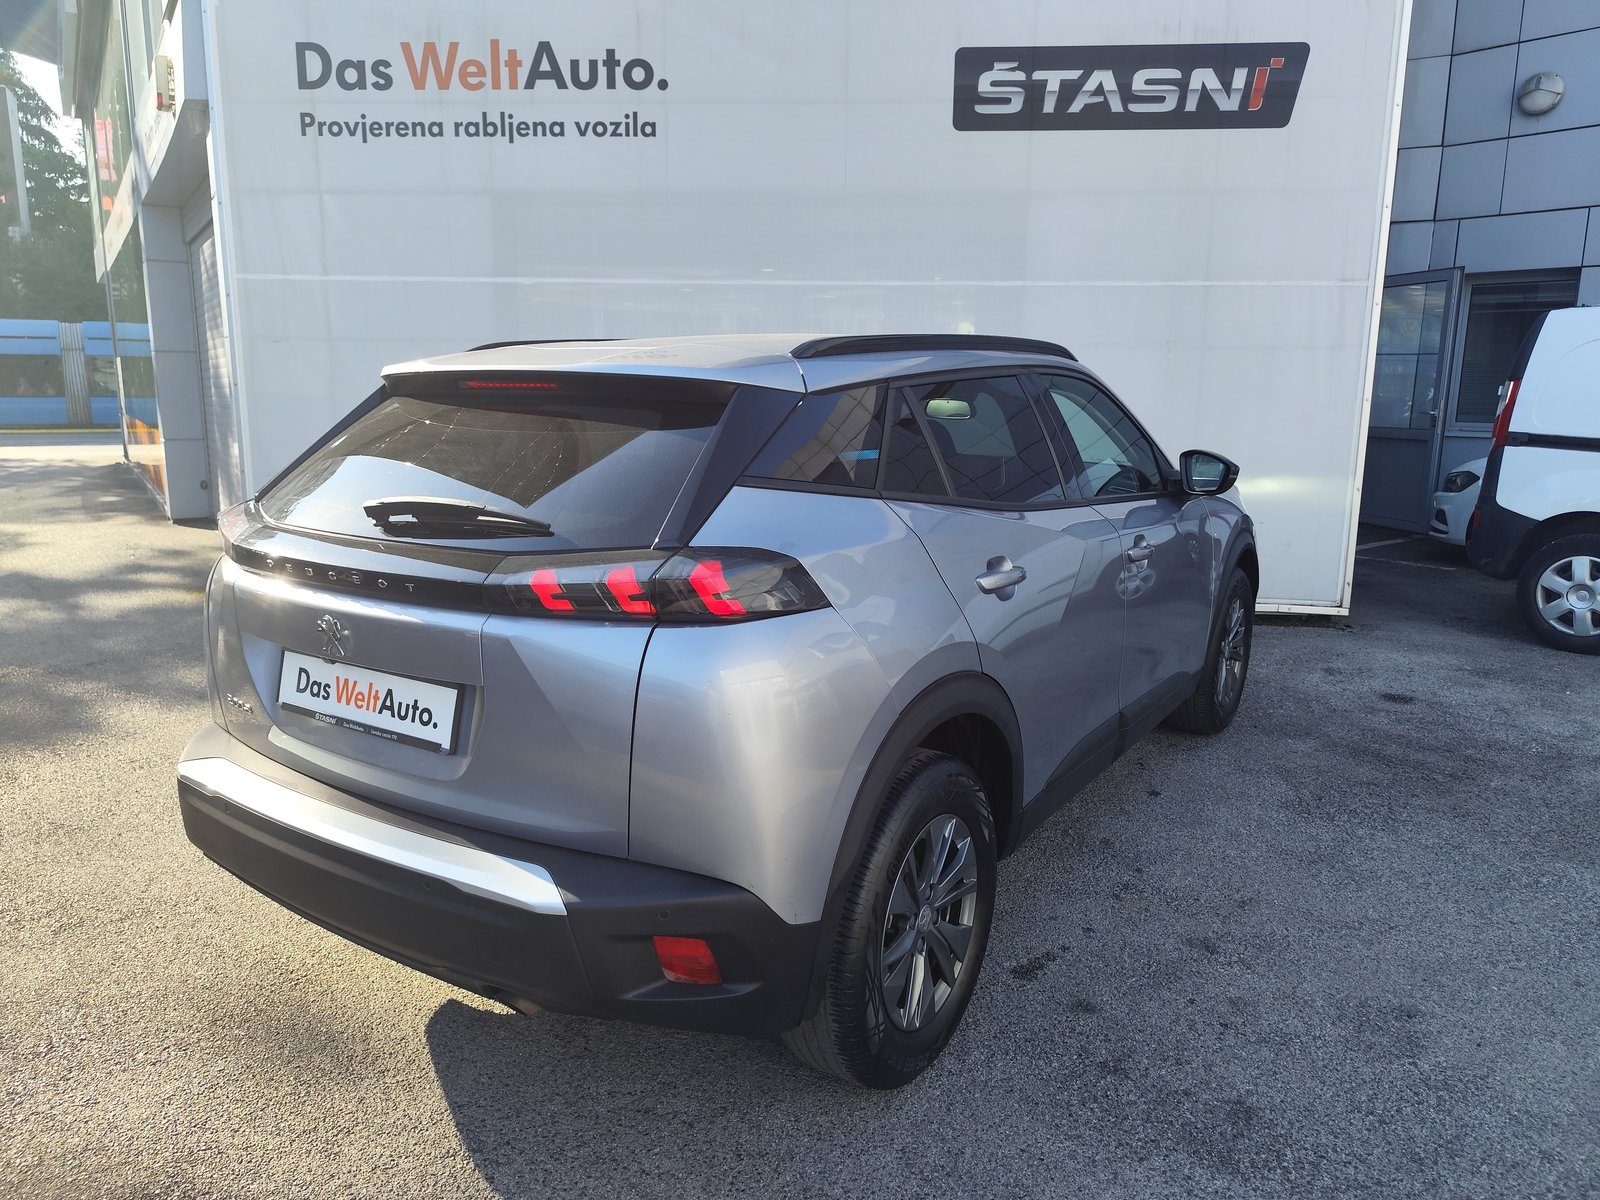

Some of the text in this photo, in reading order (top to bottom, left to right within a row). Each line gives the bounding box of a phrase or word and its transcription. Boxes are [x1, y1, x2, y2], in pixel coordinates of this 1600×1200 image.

[295, 39, 669, 91] Das WeltAuto.
[300, 112, 656, 143] Provjerena rabljena vozila
[296, 667, 438, 729] Das WeltAuto.
